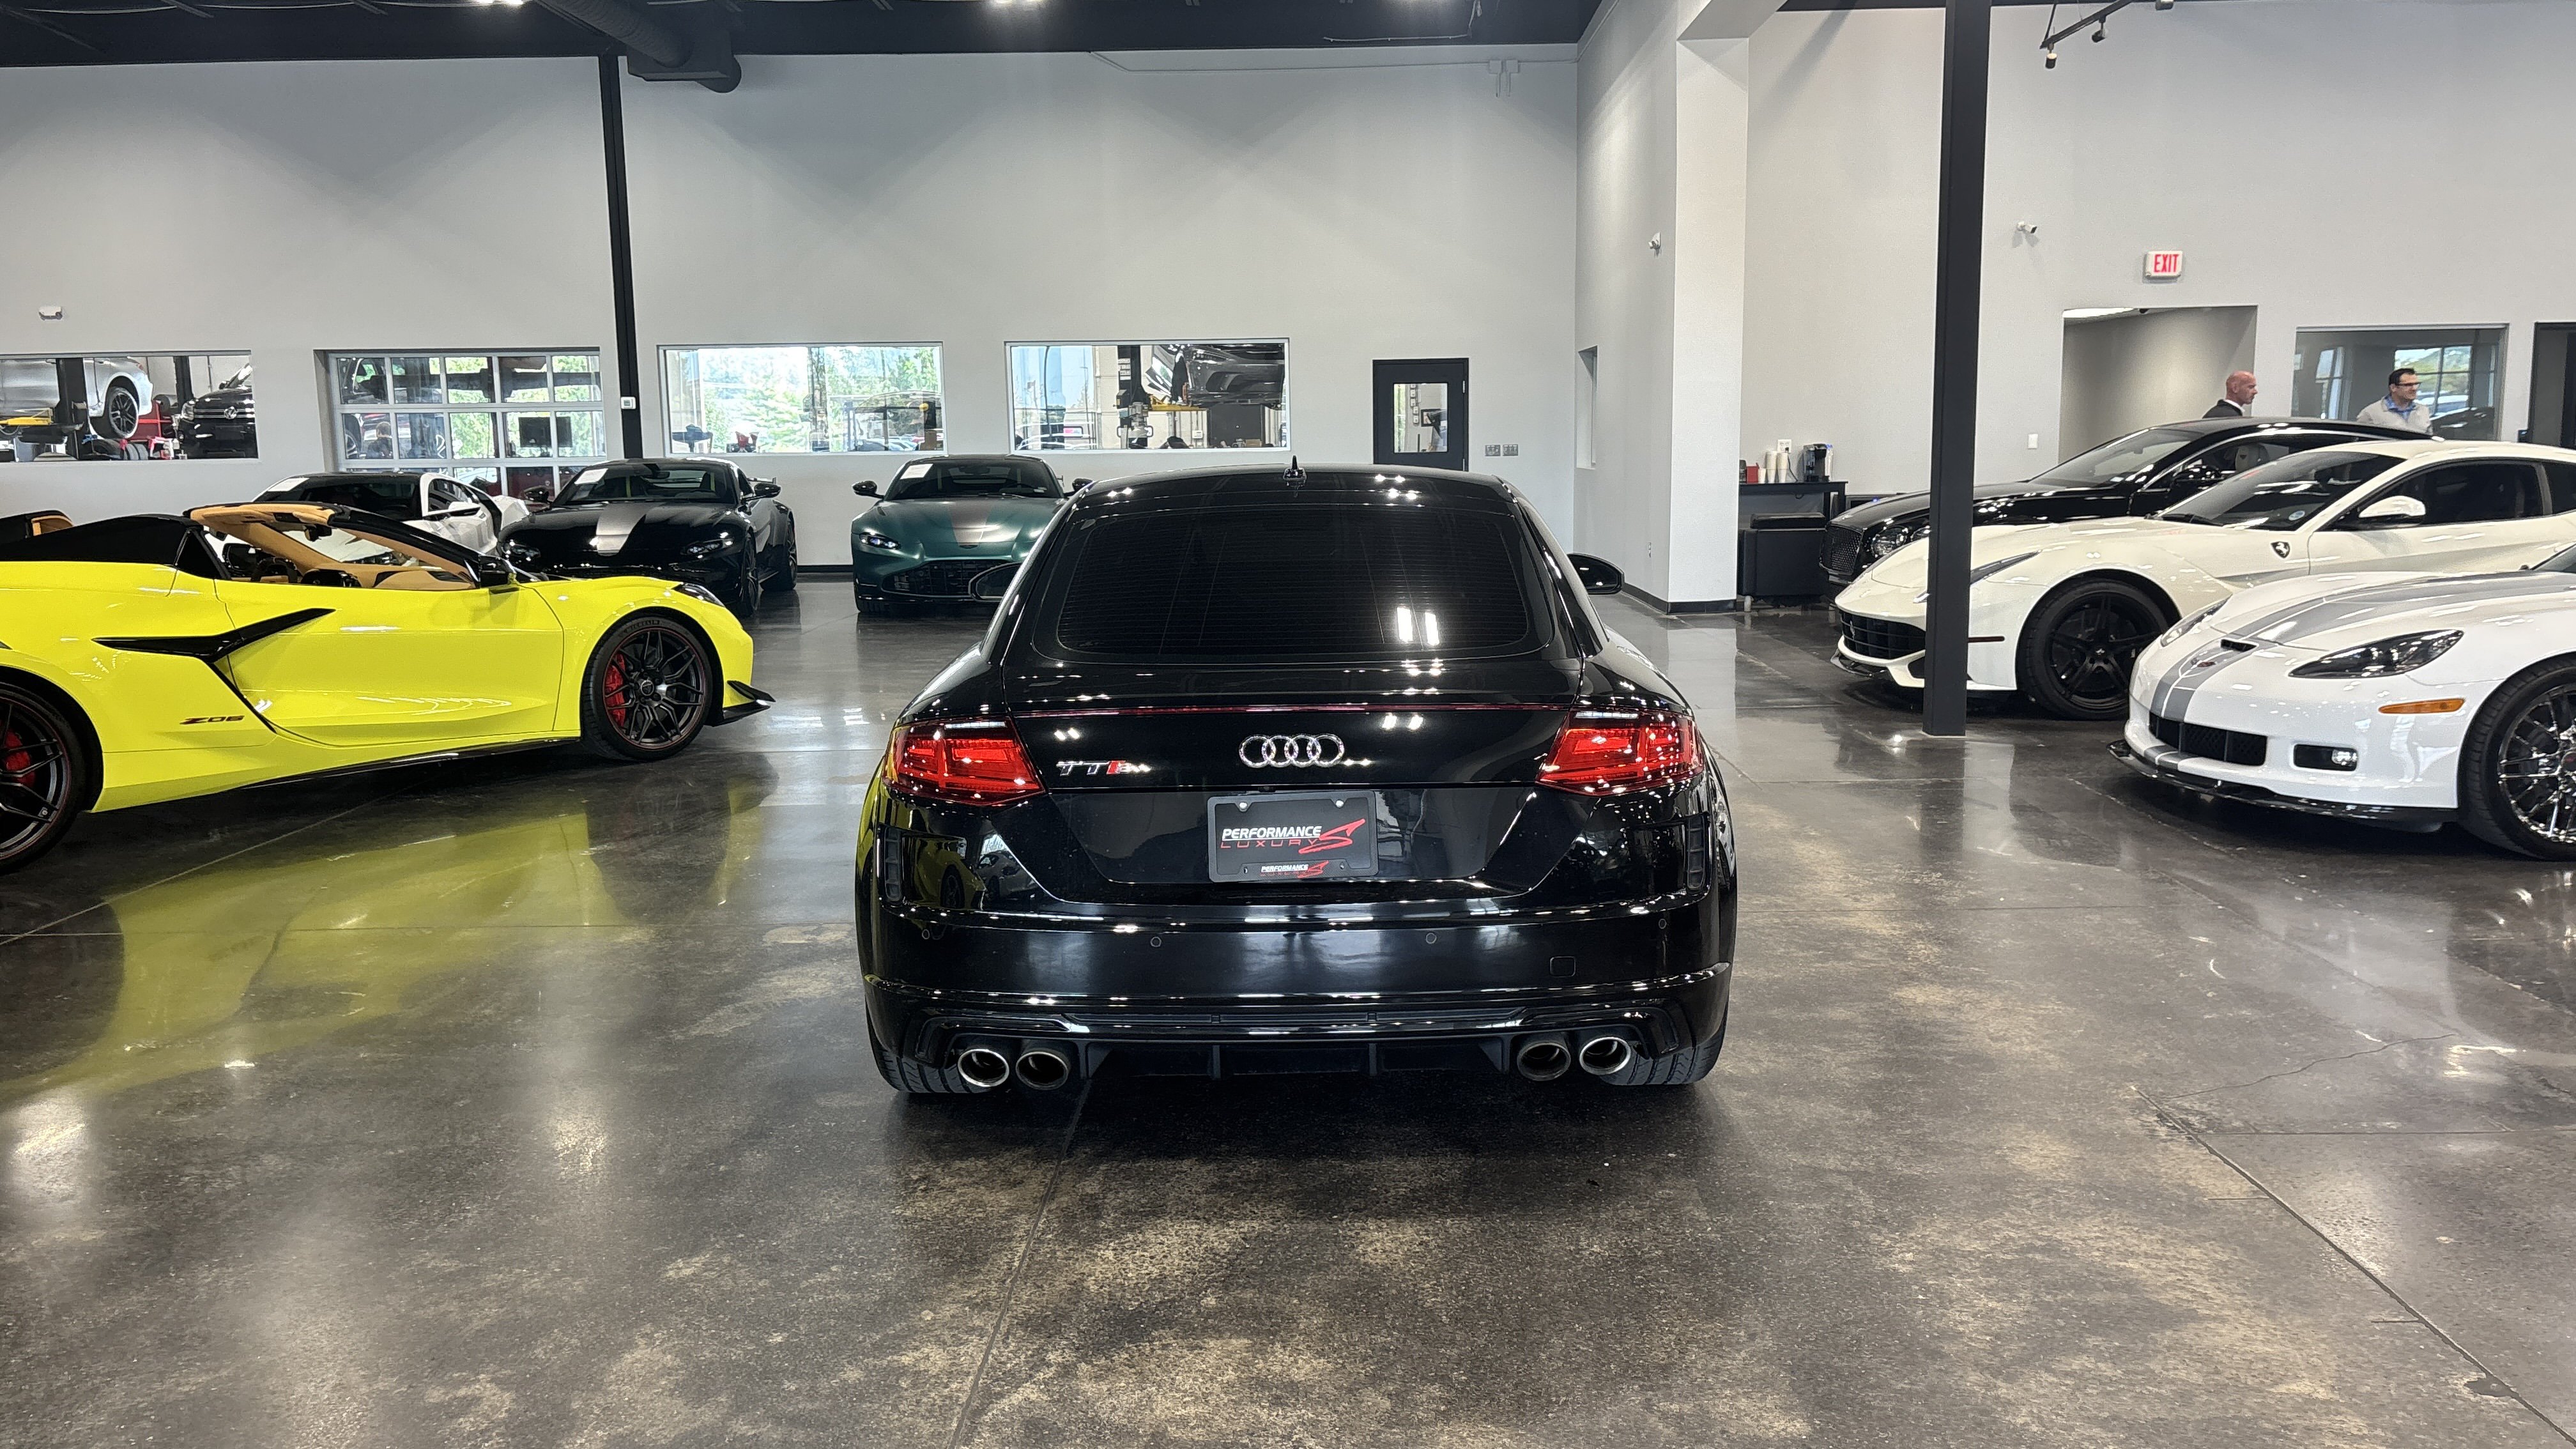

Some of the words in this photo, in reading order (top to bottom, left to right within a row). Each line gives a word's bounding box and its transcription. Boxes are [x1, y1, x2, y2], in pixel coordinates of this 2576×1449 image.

[2154, 254, 2179, 273] EXIT
[180, 716, 245, 725] Z06
[1222, 825, 1322, 839] PERFORMANCE
[1220, 839, 1319, 849] LUXURY
[1261, 864, 1309, 872] PERFORMANCE
